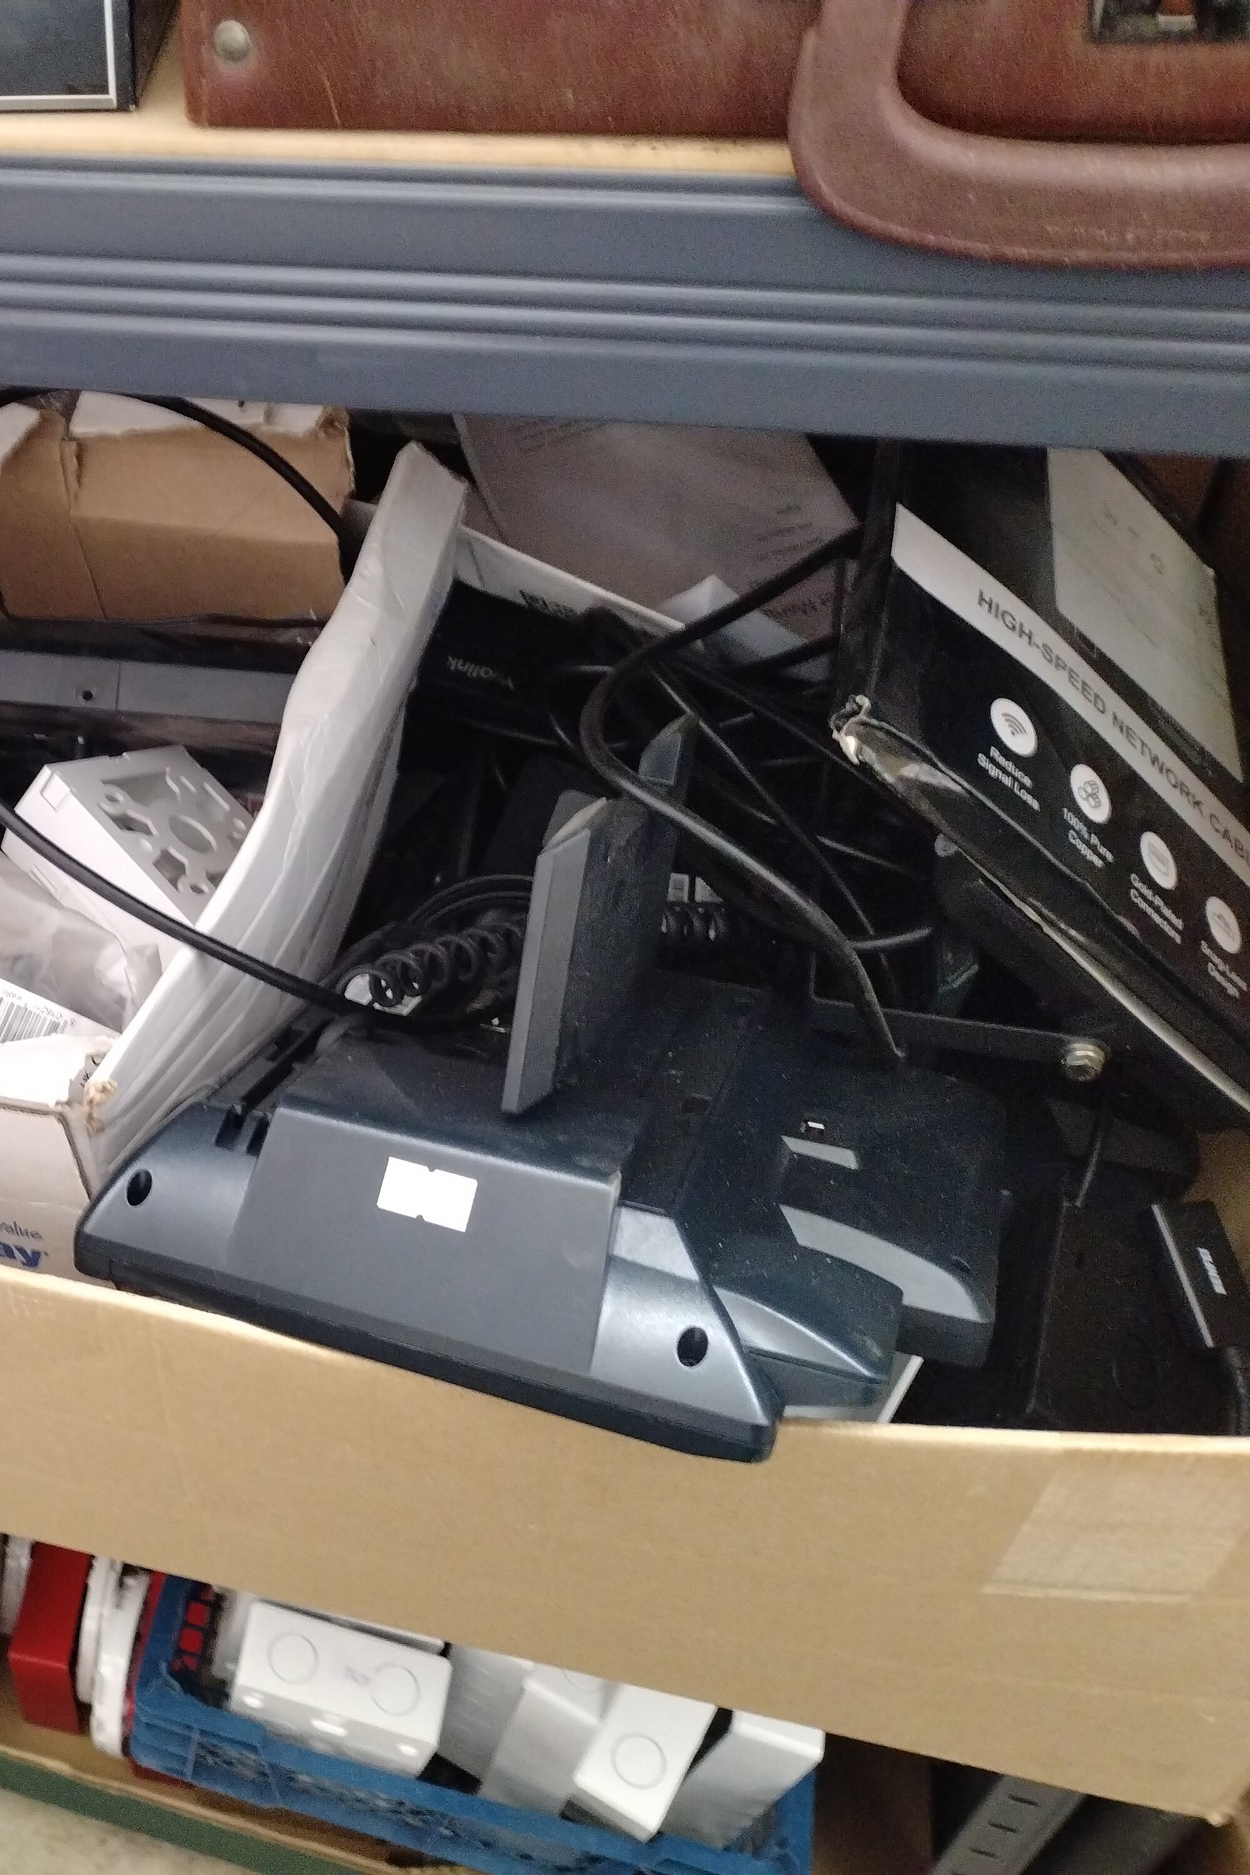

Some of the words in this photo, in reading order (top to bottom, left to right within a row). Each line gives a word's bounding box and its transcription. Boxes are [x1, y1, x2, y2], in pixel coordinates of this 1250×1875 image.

[977, 588, 1107, 716] HIGH-SPEED
[1111, 711, 1205, 818] NETWORK
[977, 753, 1015, 789] Signal
[1014, 780, 1041, 812] Loss
[989, 746, 1033, 789] Reduce
[1063, 807, 1091, 842] 100%
[1090, 832, 1115, 863] Pure
[1068, 829, 1106, 869] Copper
